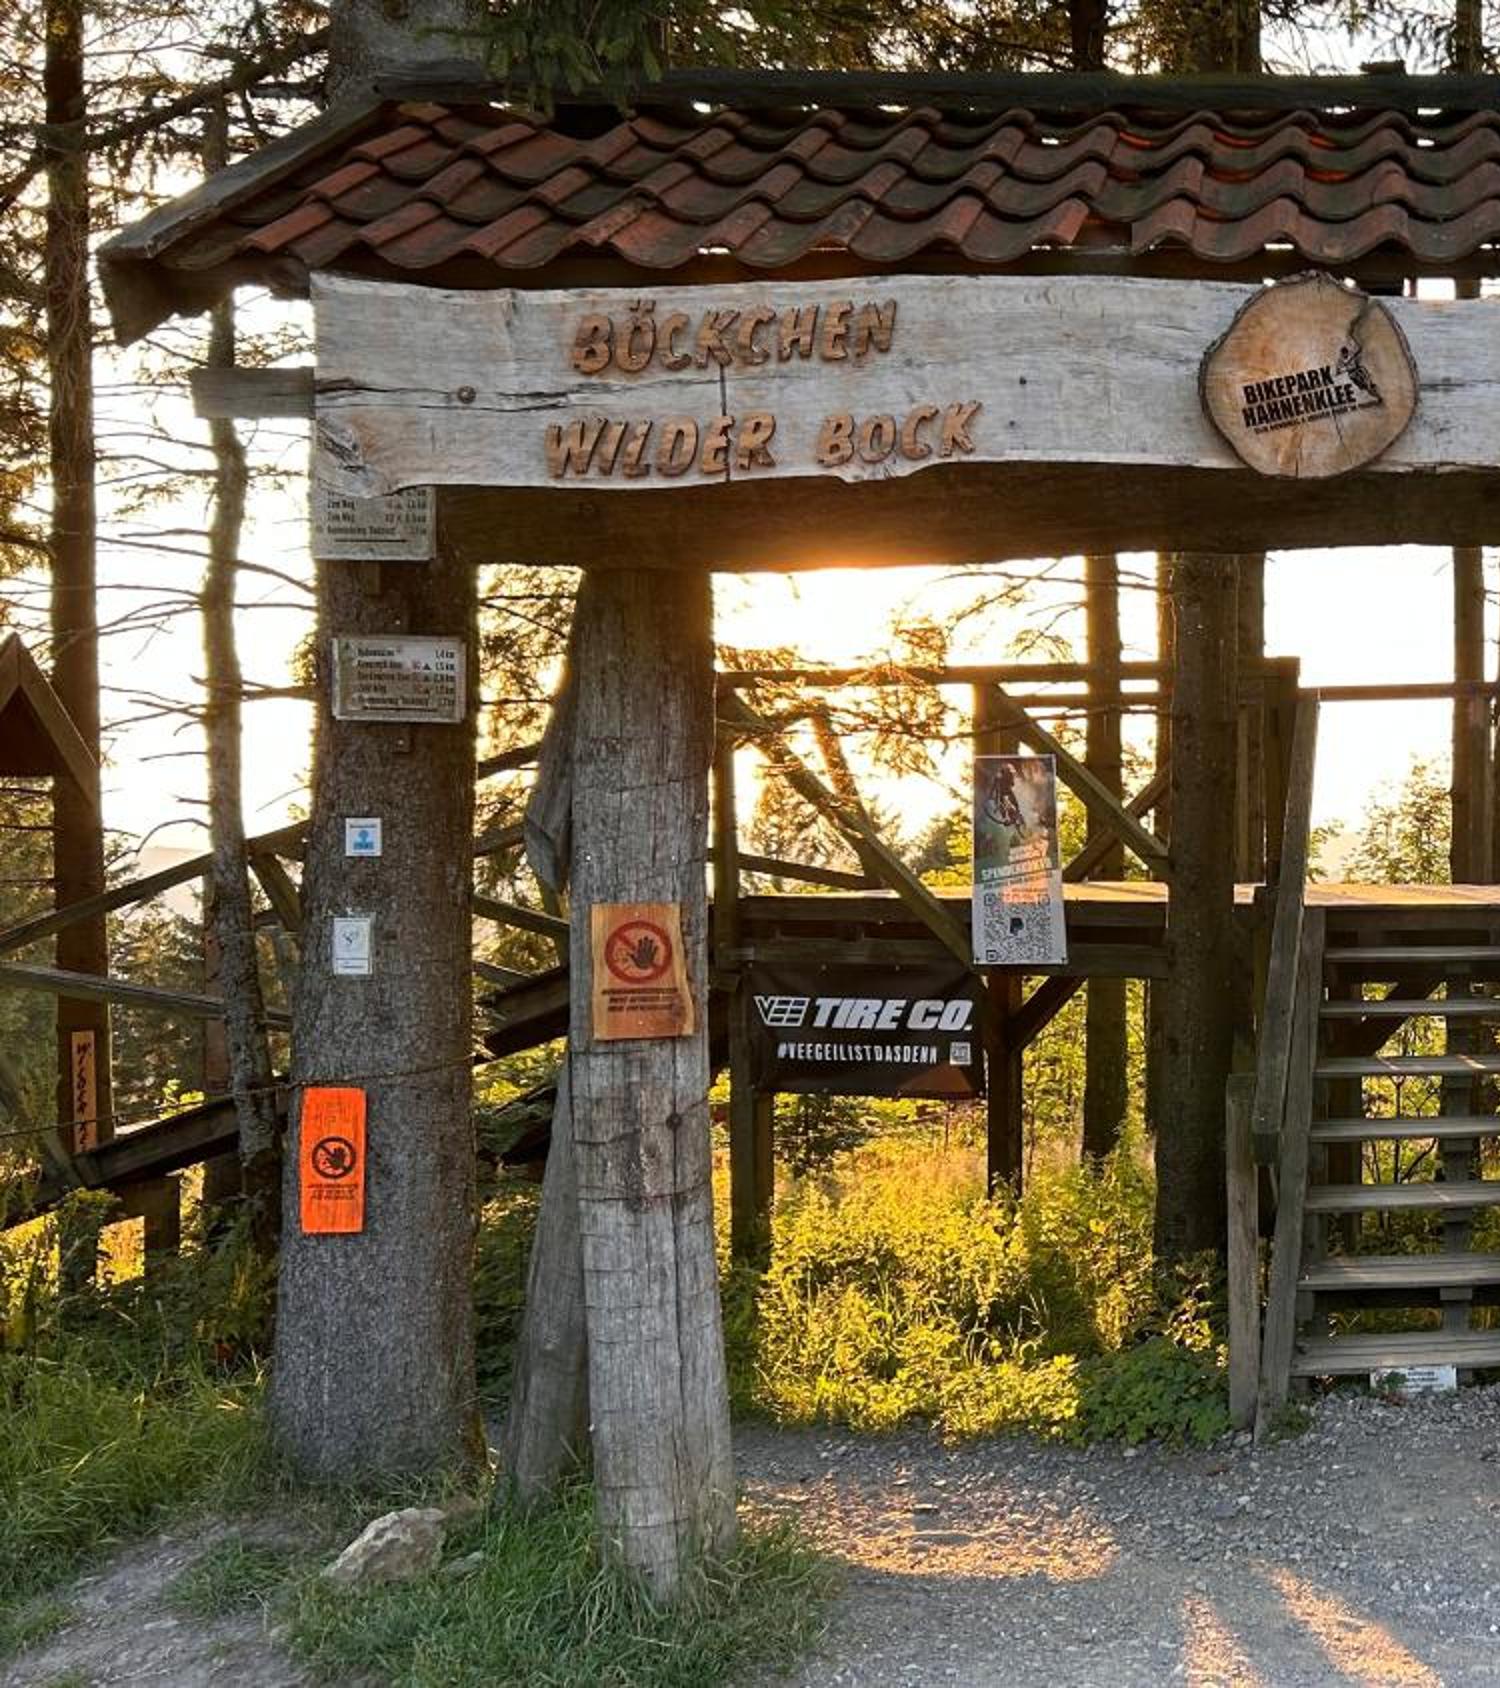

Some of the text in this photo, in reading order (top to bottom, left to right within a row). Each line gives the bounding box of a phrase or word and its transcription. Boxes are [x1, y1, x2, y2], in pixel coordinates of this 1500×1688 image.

[572, 299, 899, 375] BÖCKCHEN
[1241, 384, 1357, 428] HAHNENKLEE
[1242, 365, 1335, 405] BIKEPARK
[546, 401, 984, 479] WILDER BOCK
[812, 998, 906, 1030] TIRE
[906, 1000, 973, 1031] CO.
[777, 1042, 937, 1064] #VEEGEILISTDASDENN
